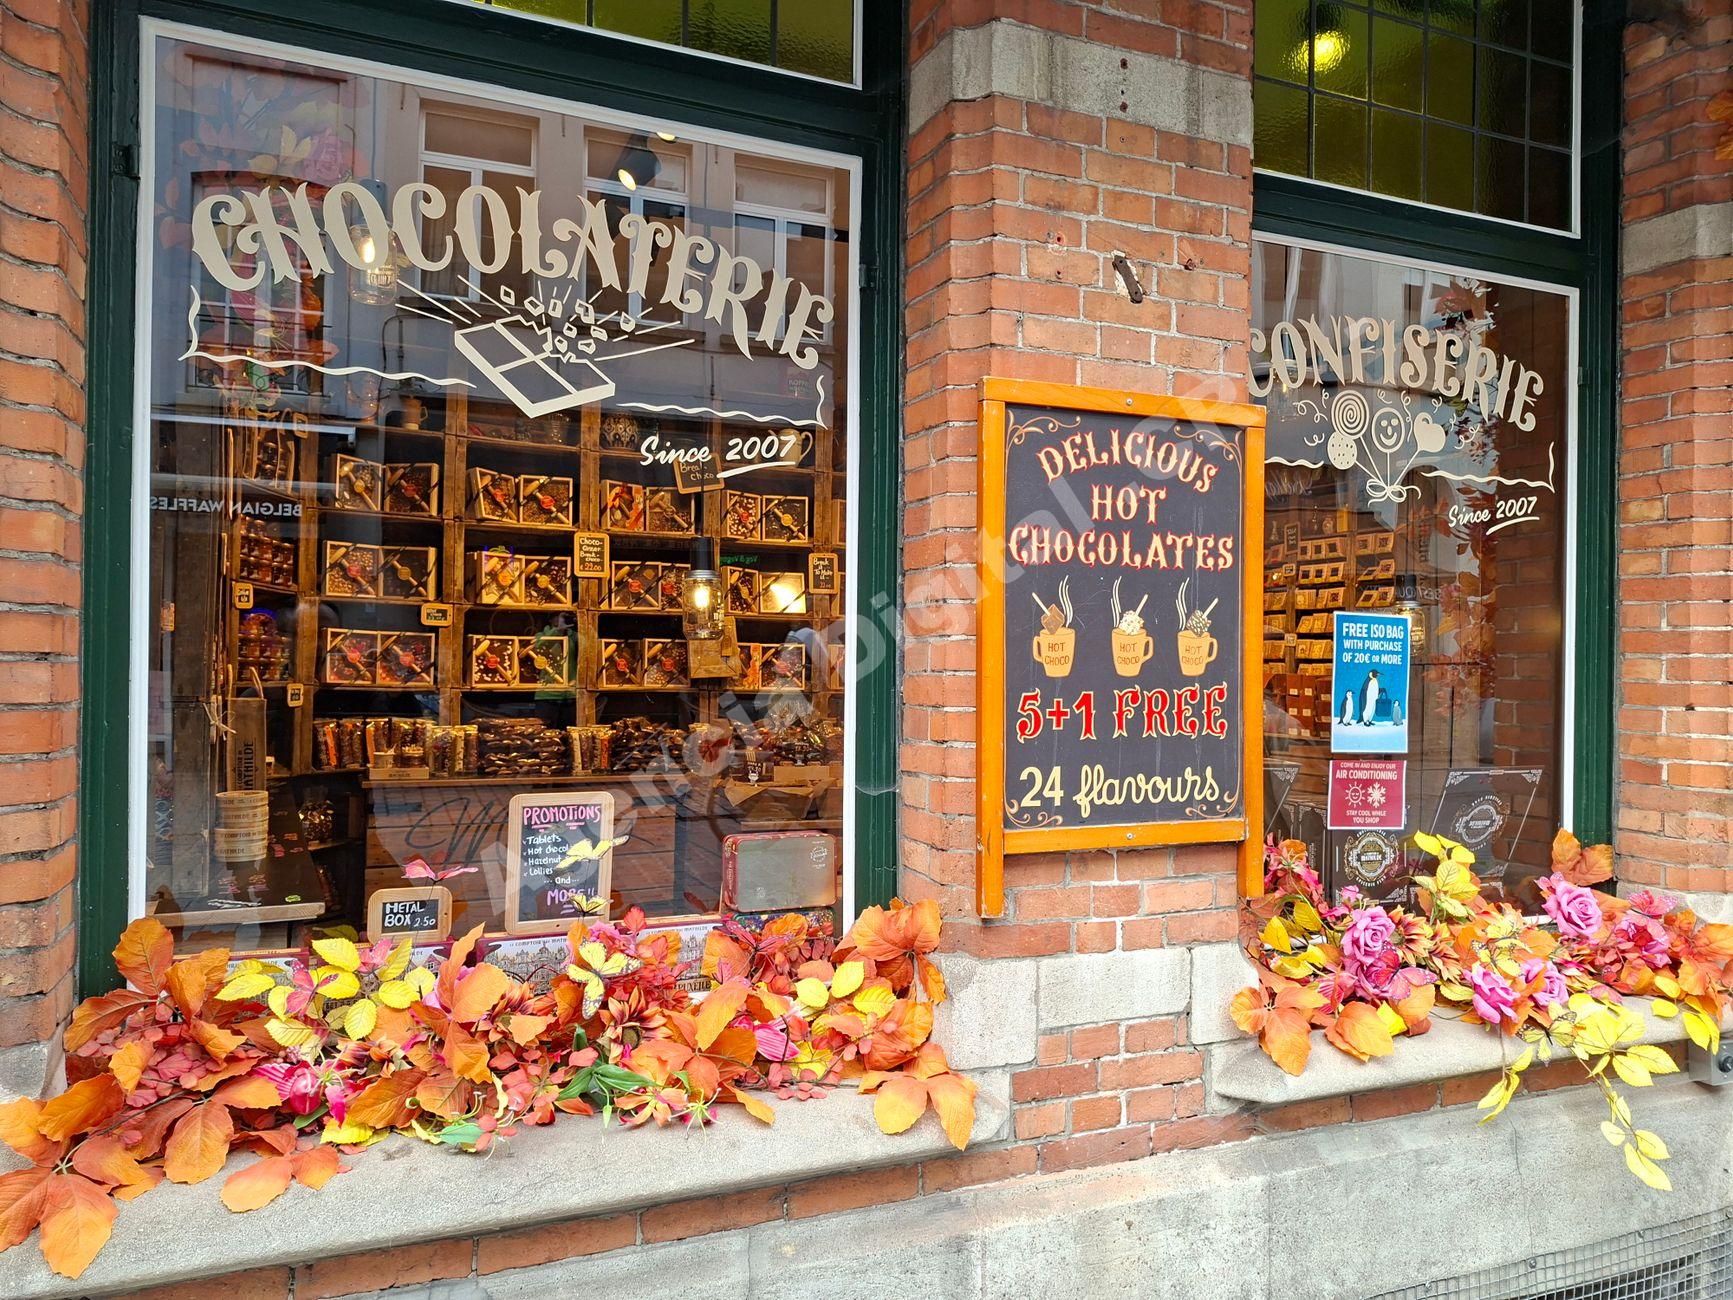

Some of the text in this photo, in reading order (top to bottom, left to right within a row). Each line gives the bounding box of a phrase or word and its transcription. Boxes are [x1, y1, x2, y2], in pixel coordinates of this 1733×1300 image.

[192, 181, 835, 371] CHOCOLATERIE
[1248, 313, 1545, 432] CONFISERIE
[639, 435, 797, 467] Since 2007
[1035, 428, 1220, 494] DELICIOUS
[1091, 484, 1167, 526] HOT
[1448, 496, 1538, 528] Since 2007
[1007, 521, 1235, 573] CHOCOLATES
[1342, 622, 1404, 639] FREE ISO BAG
[1048, 642, 1065, 653] HOT
[1343, 639, 1402, 652] WITH PURCHASE
[1342, 652, 1402, 665] OF 20€ OR MORE
[1016, 681, 1228, 744] 5+1 FREE
[1336, 770, 1398, 780] AIR CONDITIONING
[1018, 764, 1220, 819] 24 flavours
[526, 833, 562, 845] Tablets
[527, 847, 543, 855] Hot
[529, 867, 554, 876] Lollies
[385, 901, 425, 914] METAL
[384, 914, 436, 927] BOX 2.50
